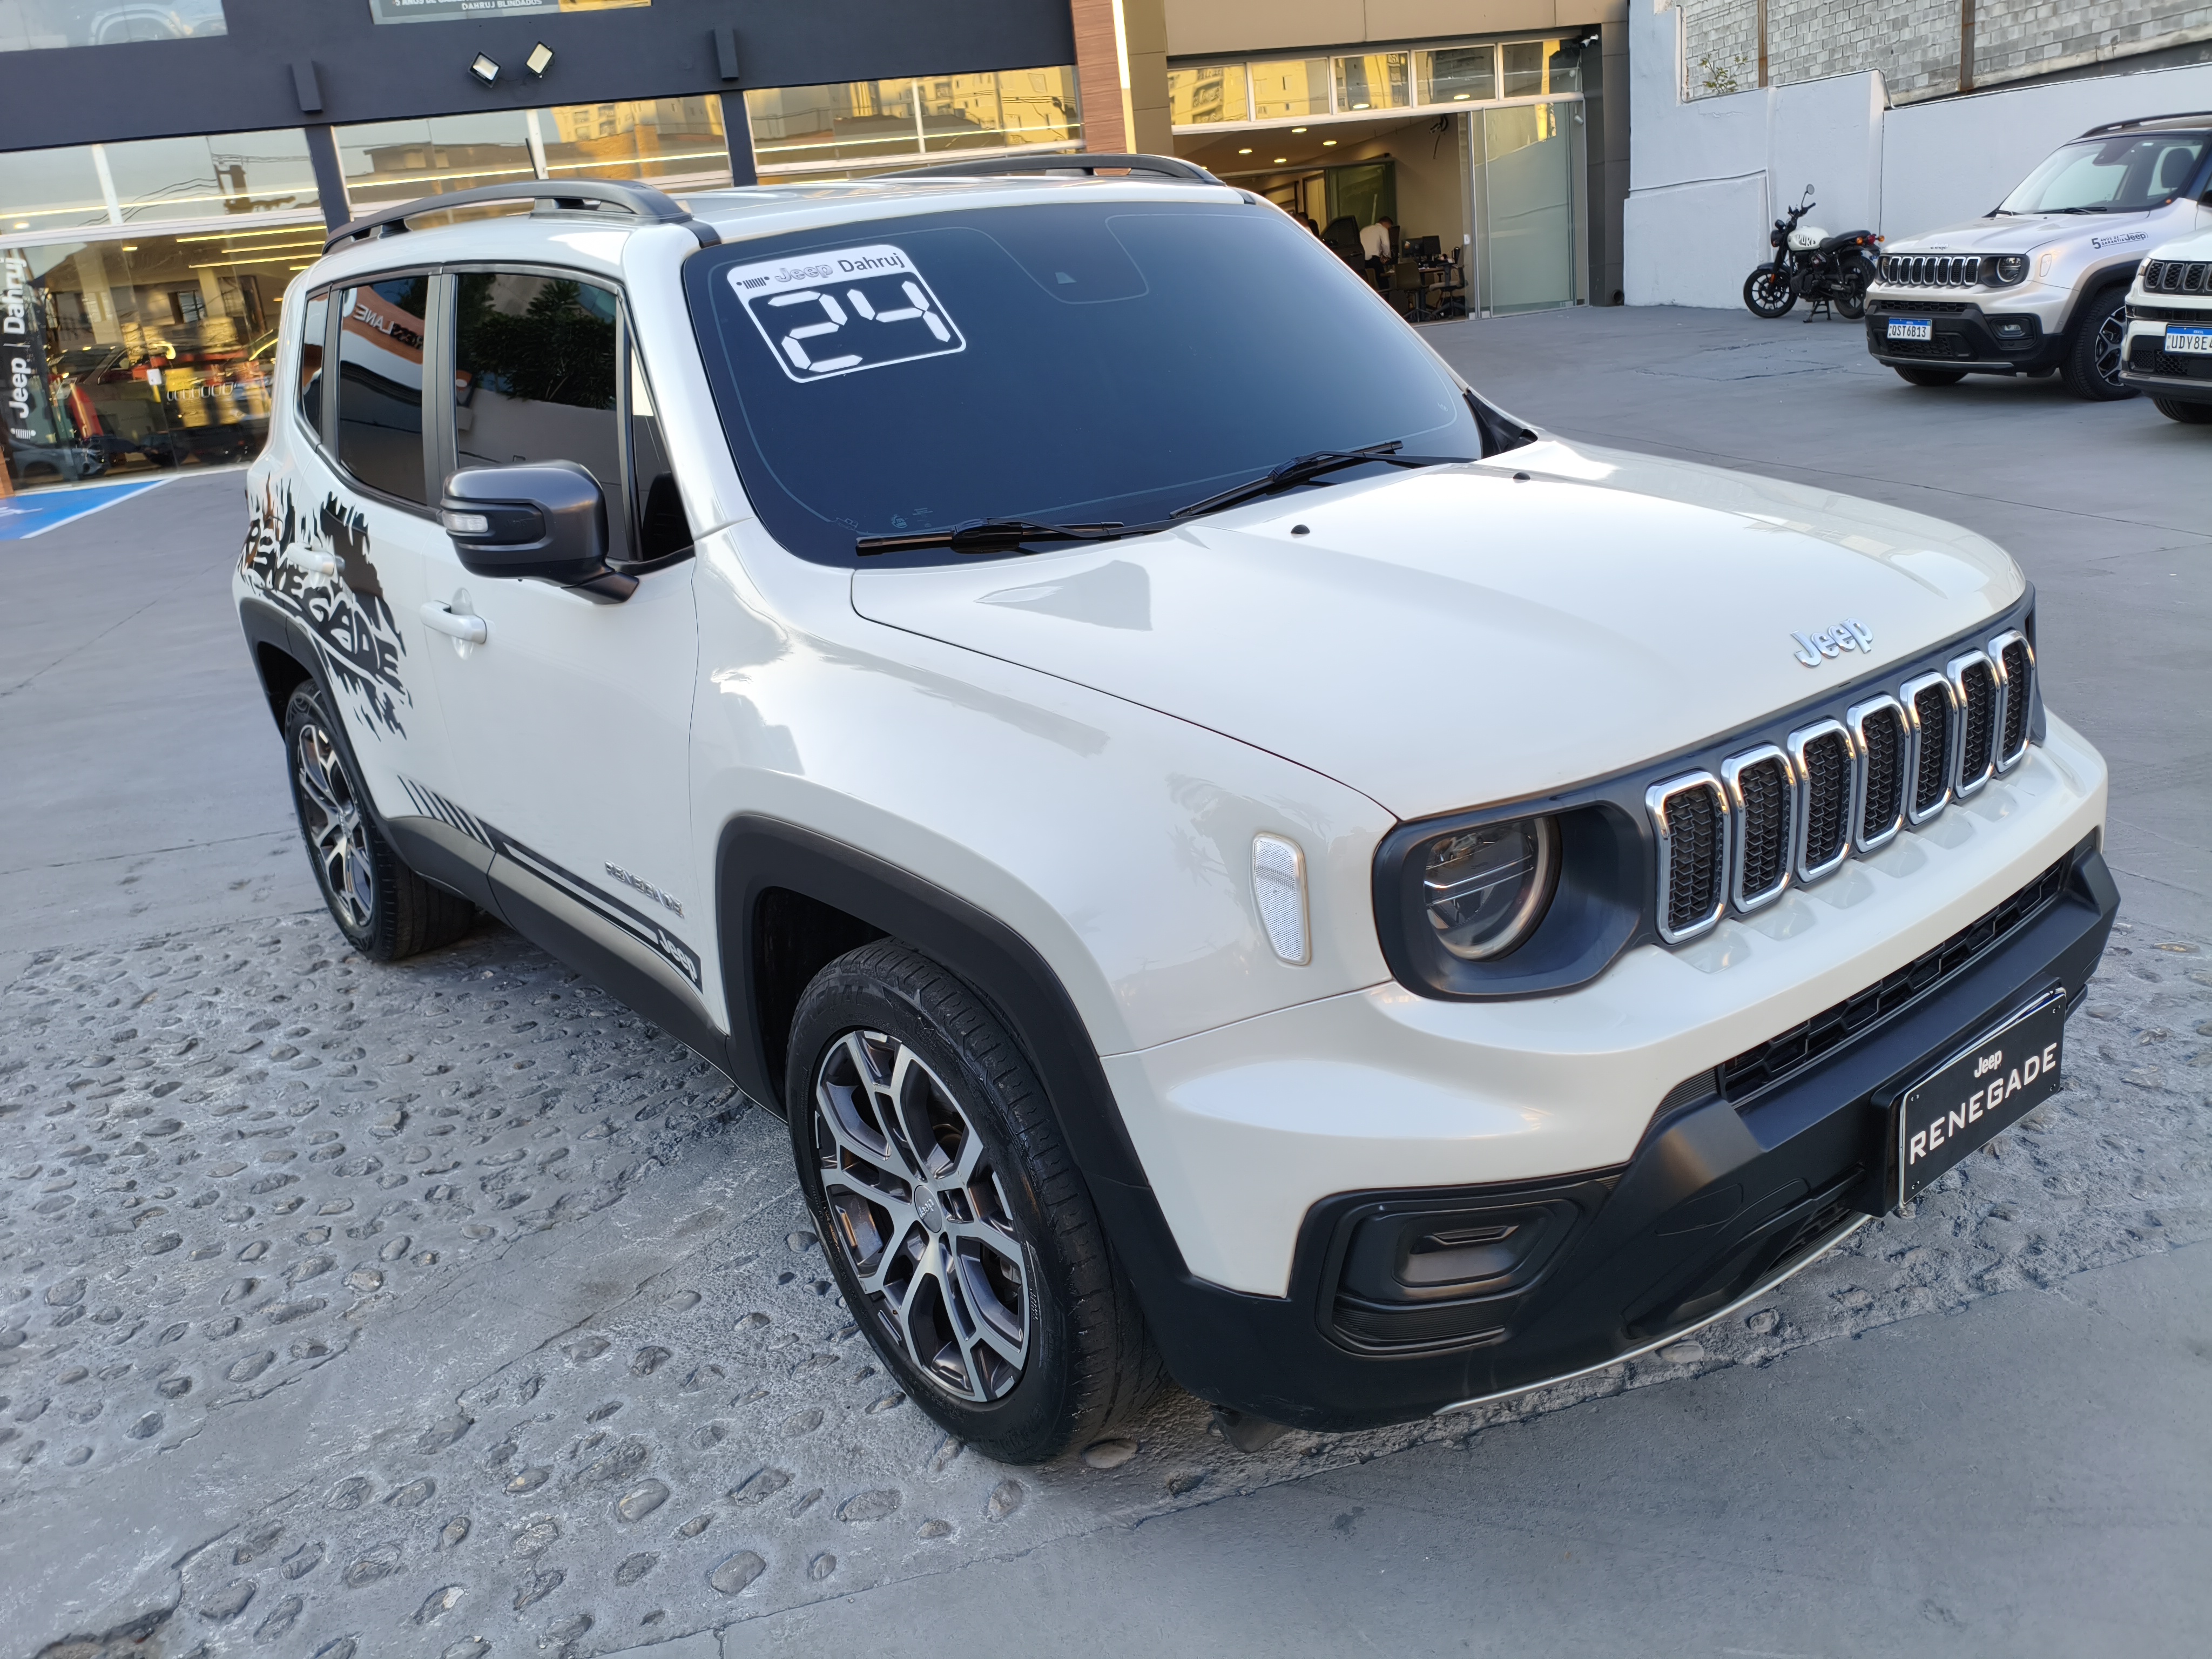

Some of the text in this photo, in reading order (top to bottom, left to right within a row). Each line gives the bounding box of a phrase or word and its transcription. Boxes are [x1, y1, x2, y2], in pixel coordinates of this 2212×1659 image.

[462, 1, 496, 10] DAHRUJ
[2091, 237, 2101, 249] 5
[774, 253, 905, 283] Jeep Dahruj
[0, 257, 31, 419] Jeep Dahruj
[768, 280, 951, 373] 24
[1892, 326, 1926, 337] QST6B13
[1789, 617, 1874, 669] Jeep
[658, 928, 698, 982] Jeep
[1974, 1050, 2002, 1078] Jeep
[1910, 1042, 2058, 1165] RENEGADE
